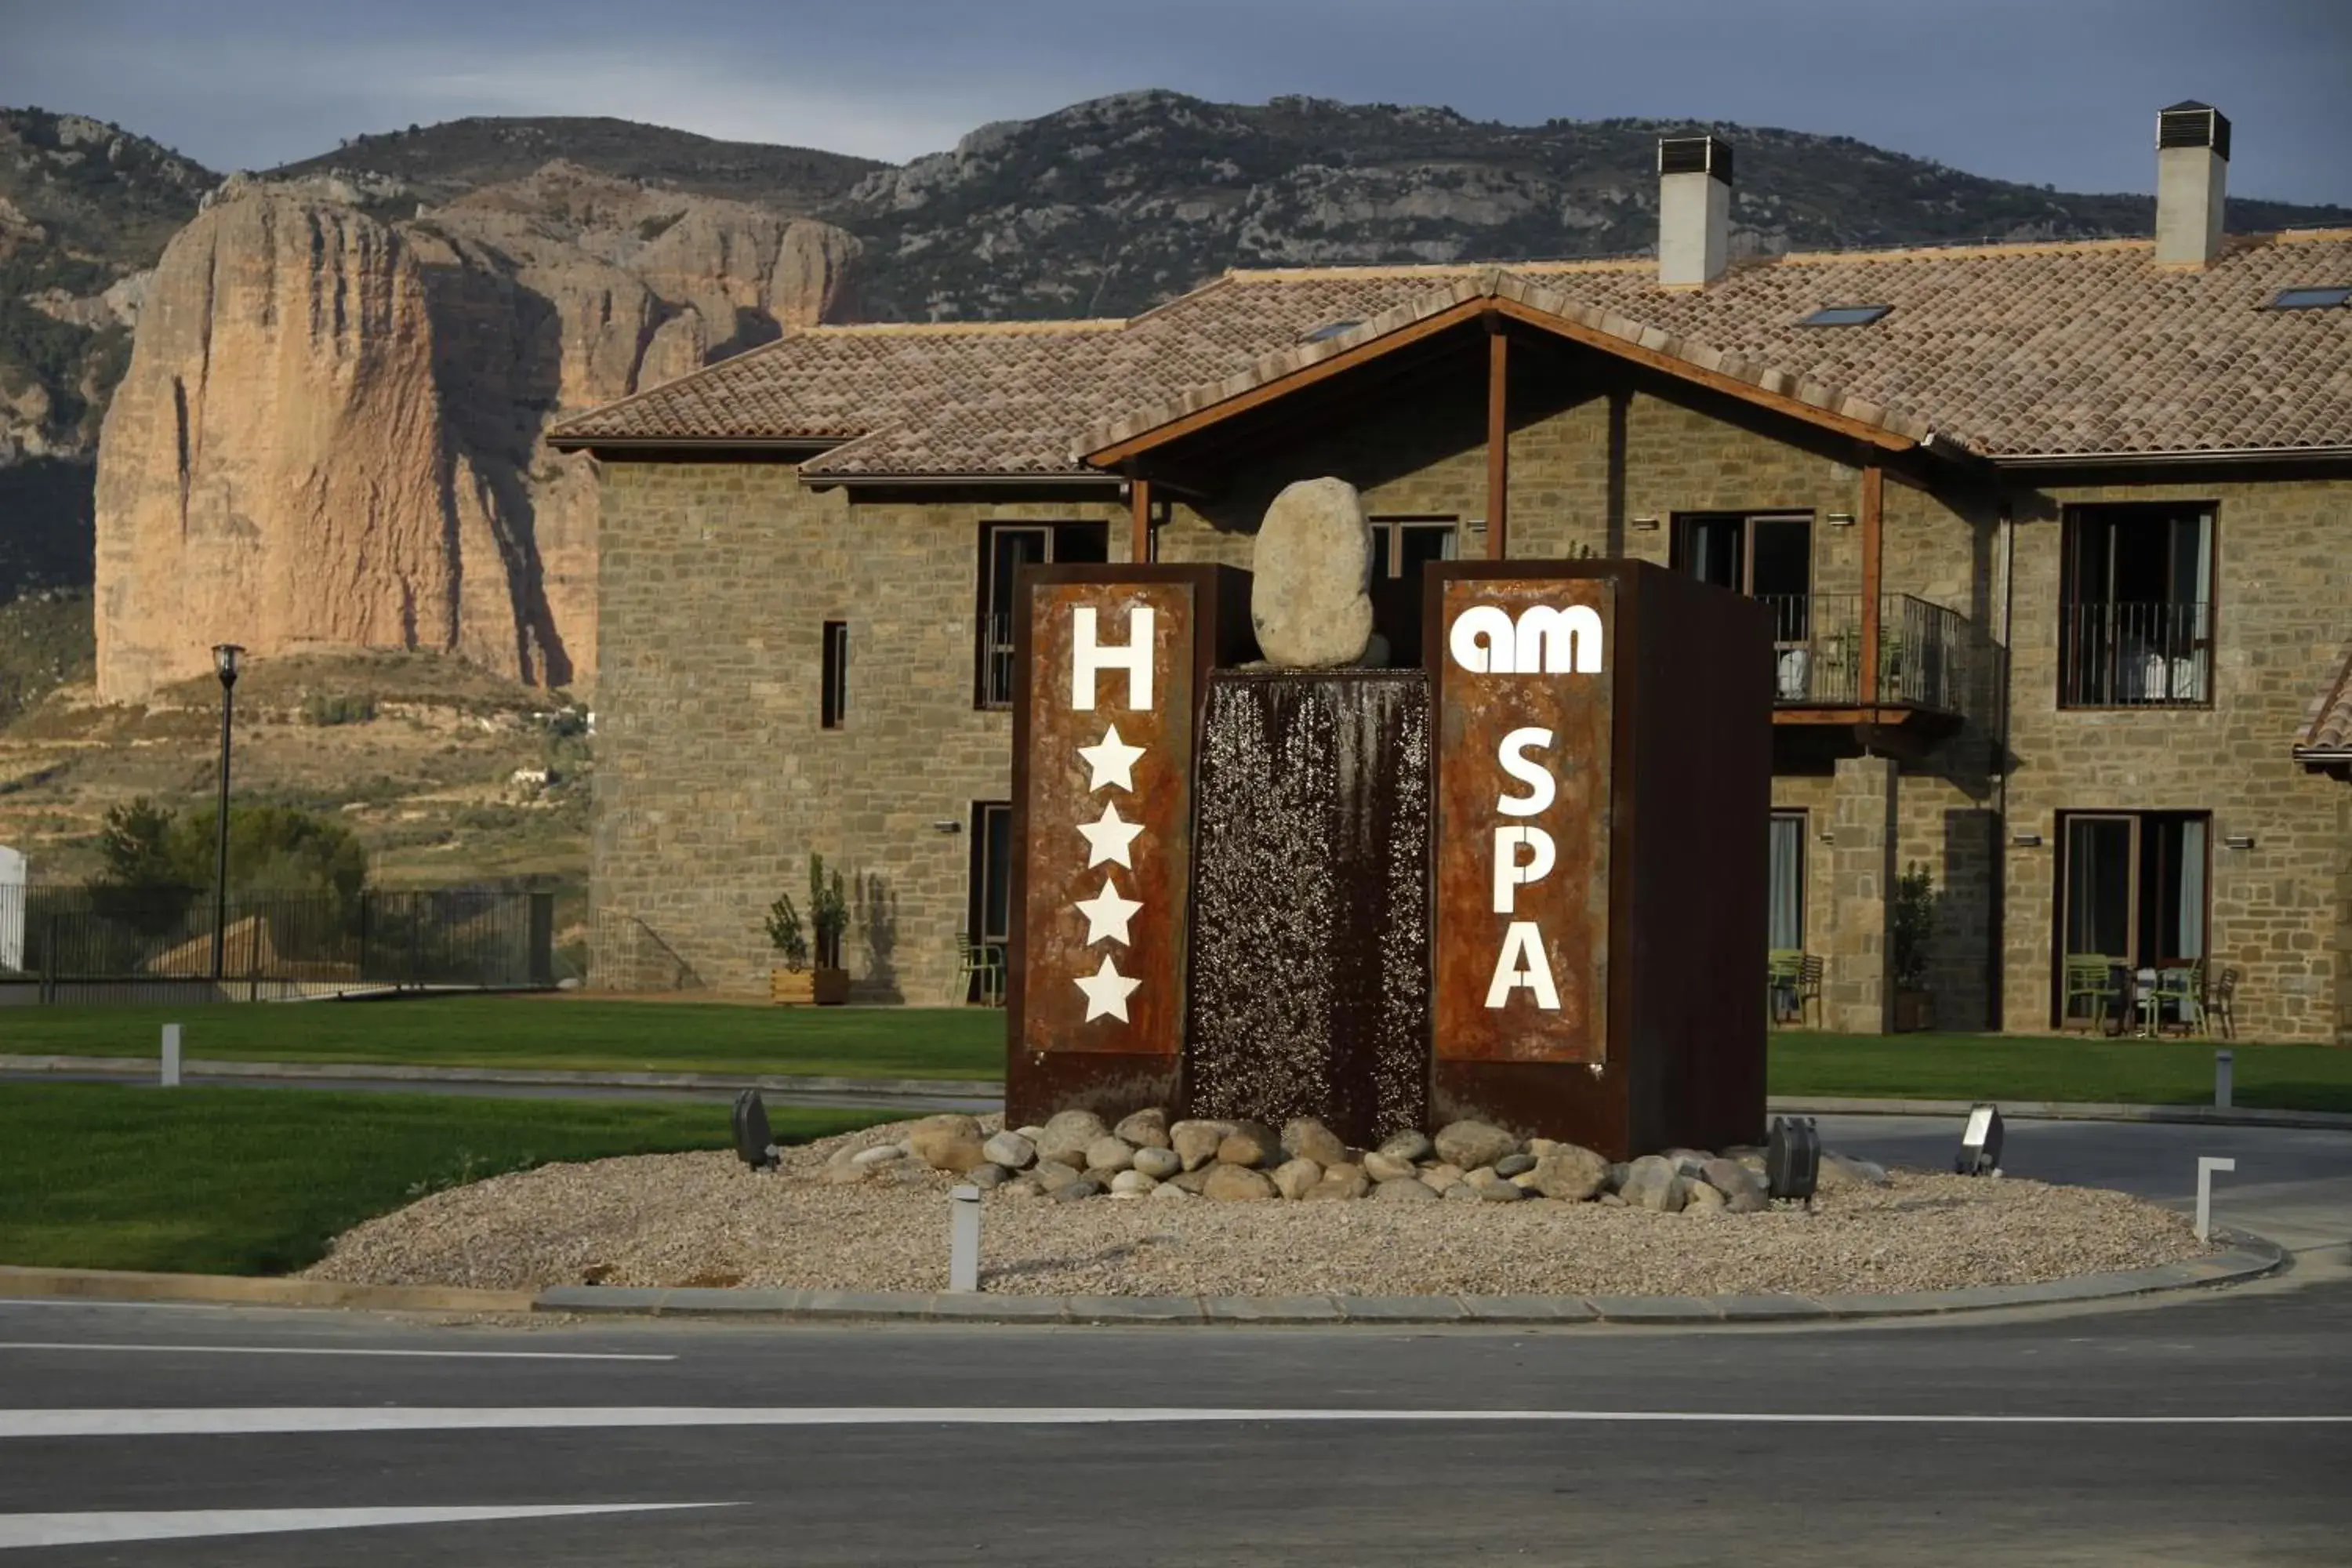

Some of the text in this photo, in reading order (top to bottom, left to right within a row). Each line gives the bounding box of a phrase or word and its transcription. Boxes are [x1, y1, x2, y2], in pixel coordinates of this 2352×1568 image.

[1072, 607, 1154, 710] H
[1449, 604, 1602, 673] am
[1484, 726, 1561, 1010] SPA
